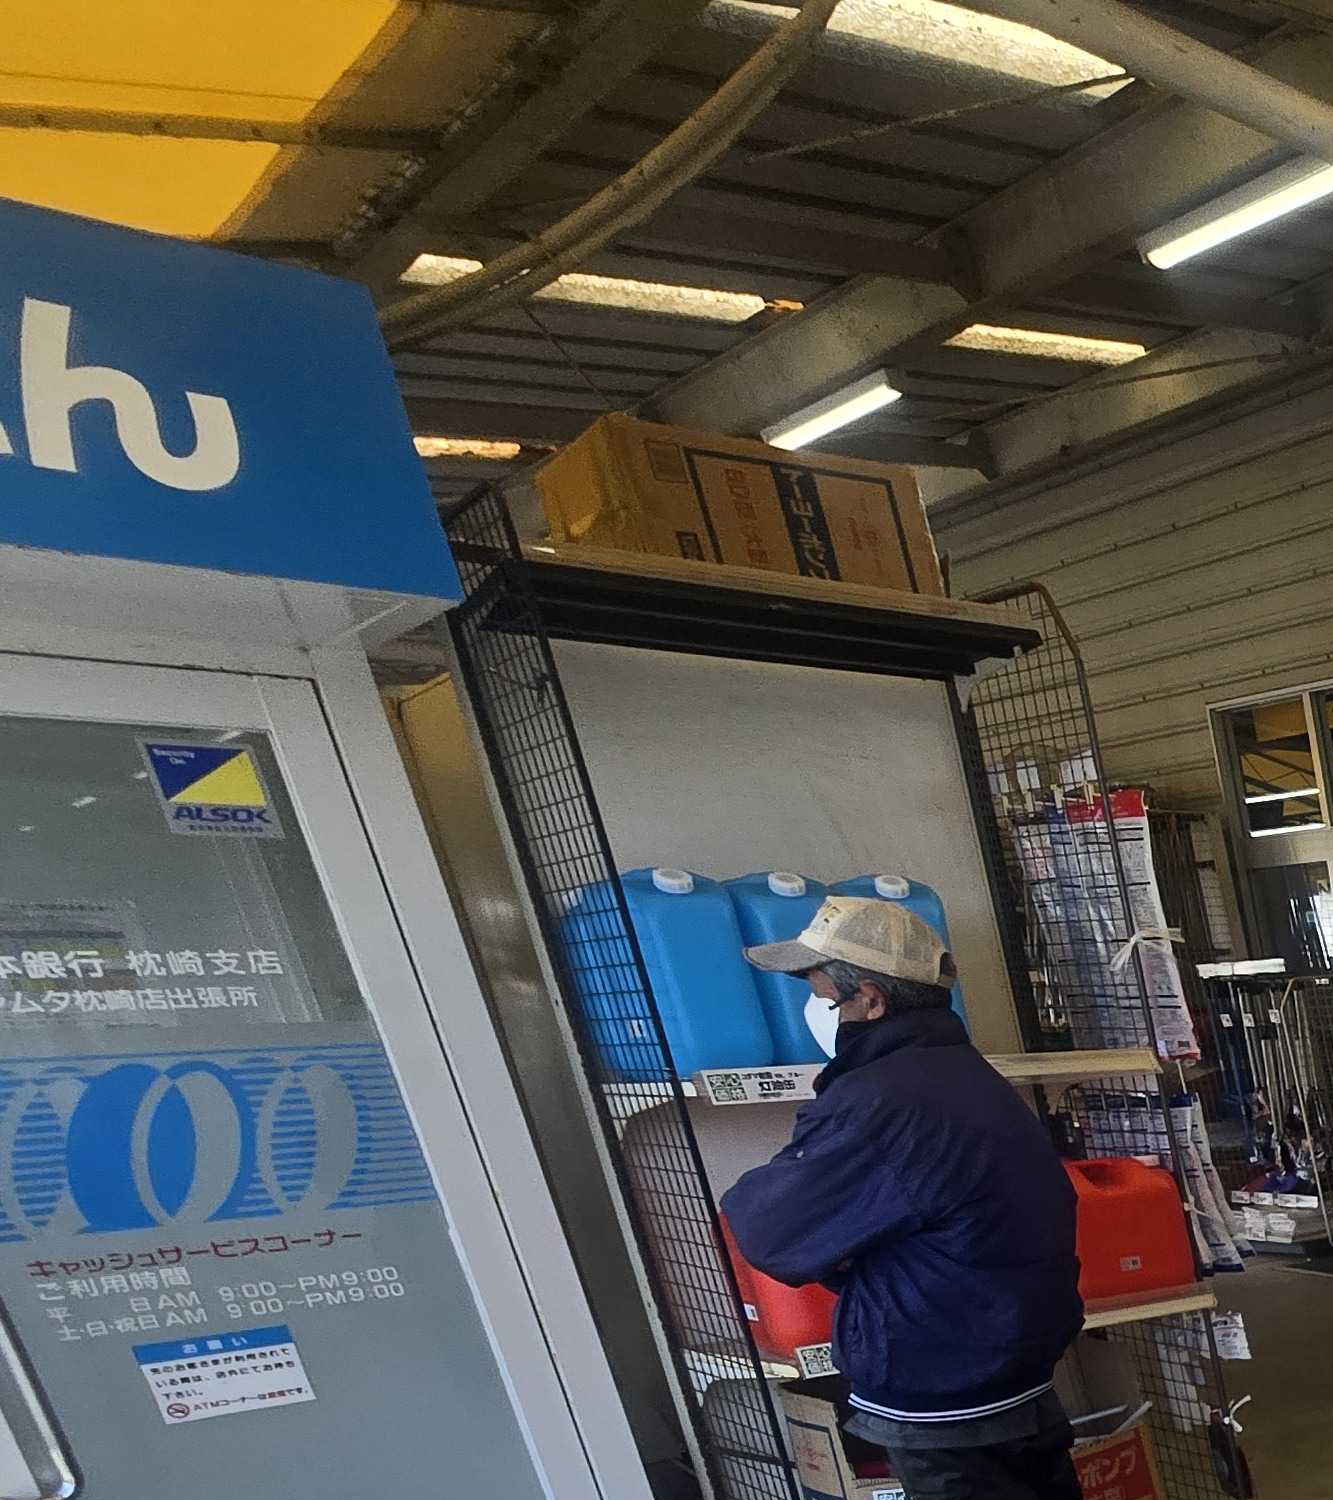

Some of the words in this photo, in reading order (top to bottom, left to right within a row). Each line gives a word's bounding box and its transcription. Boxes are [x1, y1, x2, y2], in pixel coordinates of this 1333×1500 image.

[0, 296, 242, 492] ん
[174, 805, 273, 825] ALSOK
[125, 949, 285, 978] 枕崎支店
[0, 986, 260, 1014] ムタ枕崎店出張所
[26, 1229, 363, 1279] キャッシュサービスコーナー
[36, 1267, 192, 1302] ご利用時間
